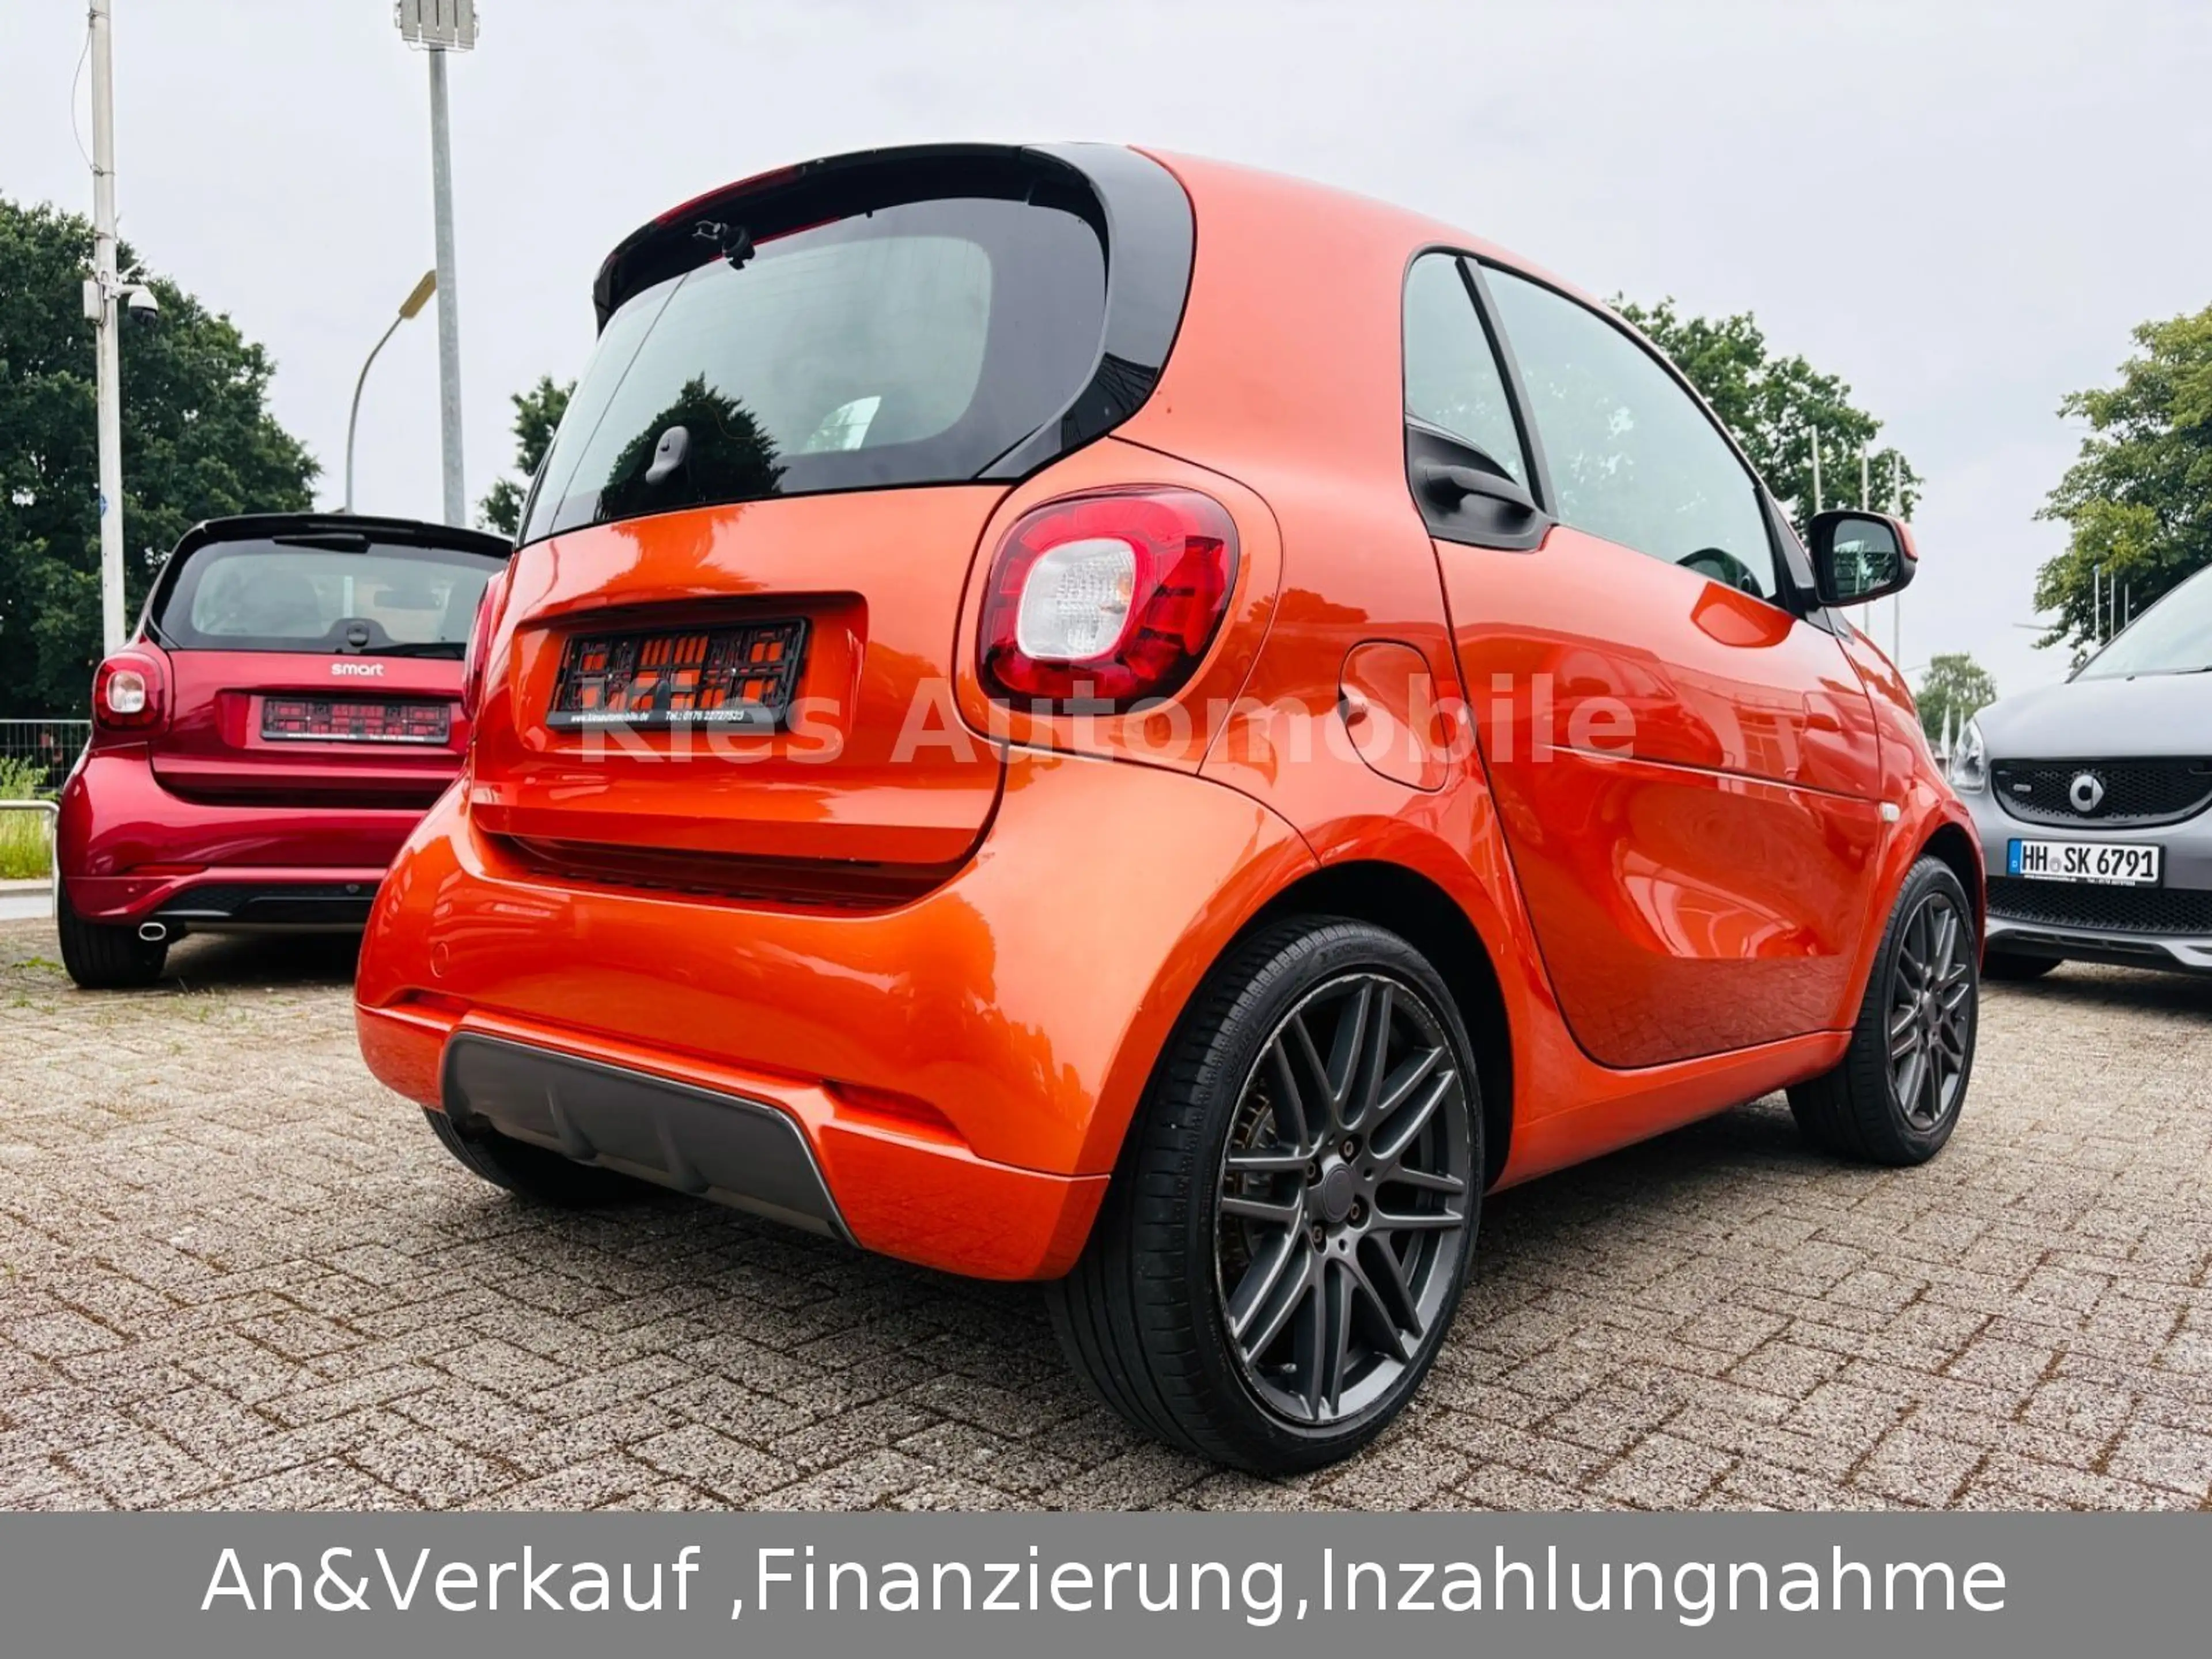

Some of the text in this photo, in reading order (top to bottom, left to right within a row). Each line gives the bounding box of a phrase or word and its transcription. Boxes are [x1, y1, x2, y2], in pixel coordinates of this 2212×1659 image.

[331, 662, 385, 677] smart
[2021, 844, 2154, 878] HH SK 6791
